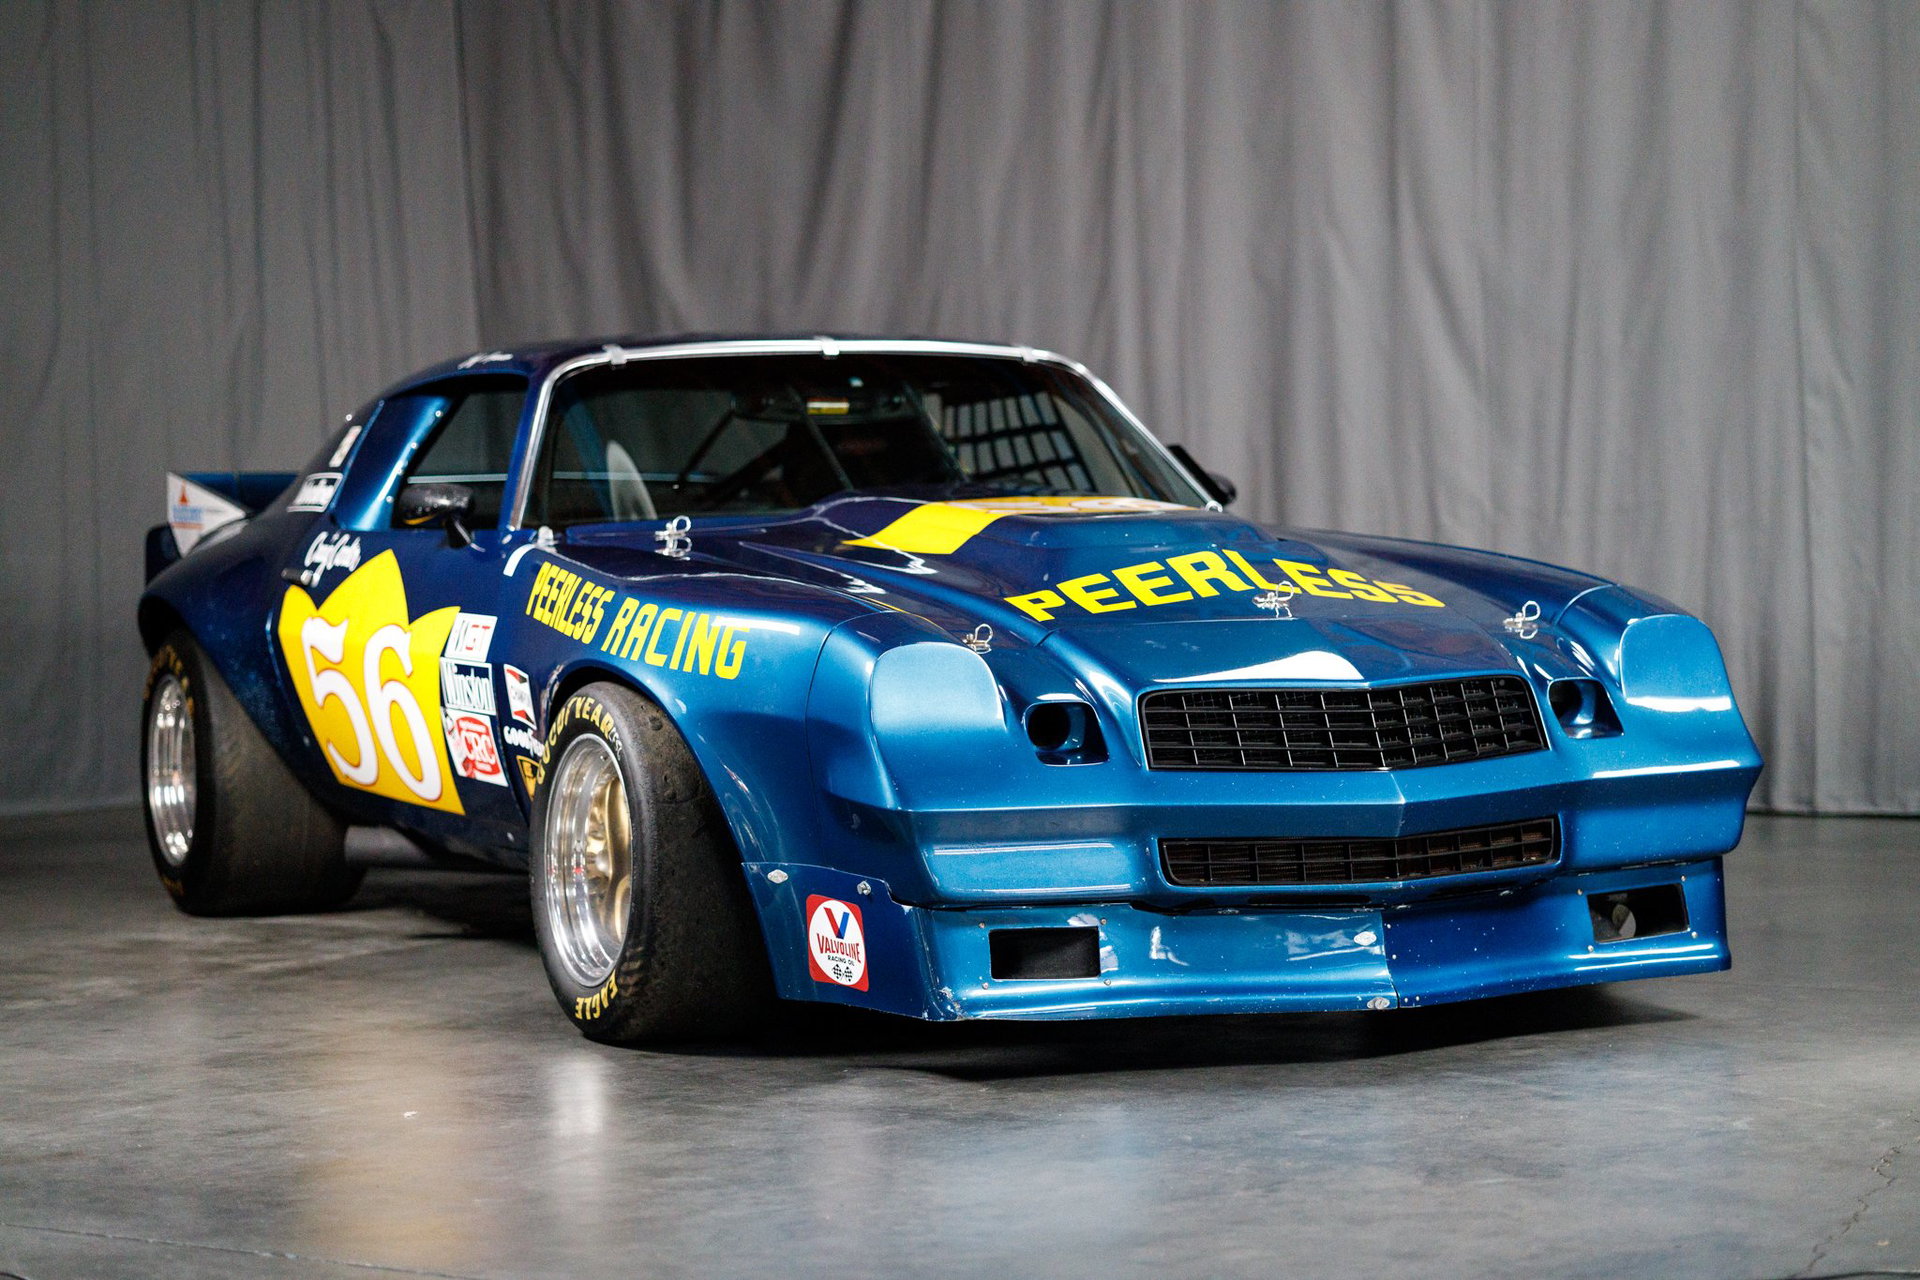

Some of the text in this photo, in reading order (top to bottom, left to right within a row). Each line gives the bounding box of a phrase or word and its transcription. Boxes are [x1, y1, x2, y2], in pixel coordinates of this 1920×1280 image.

[1004, 548, 1446, 622] PEERLESS
[526, 560, 750, 680] PEERLESS RACING
[301, 616, 442, 801] 56
[442, 662, 494, 712] Winston
[461, 730, 496, 764] CRC
[537, 696, 615, 785] GOODYEAR
[817, 933, 861, 963] VALVOLINE
[828, 956, 846, 964] RACING
[575, 969, 619, 1020] EAGLE
